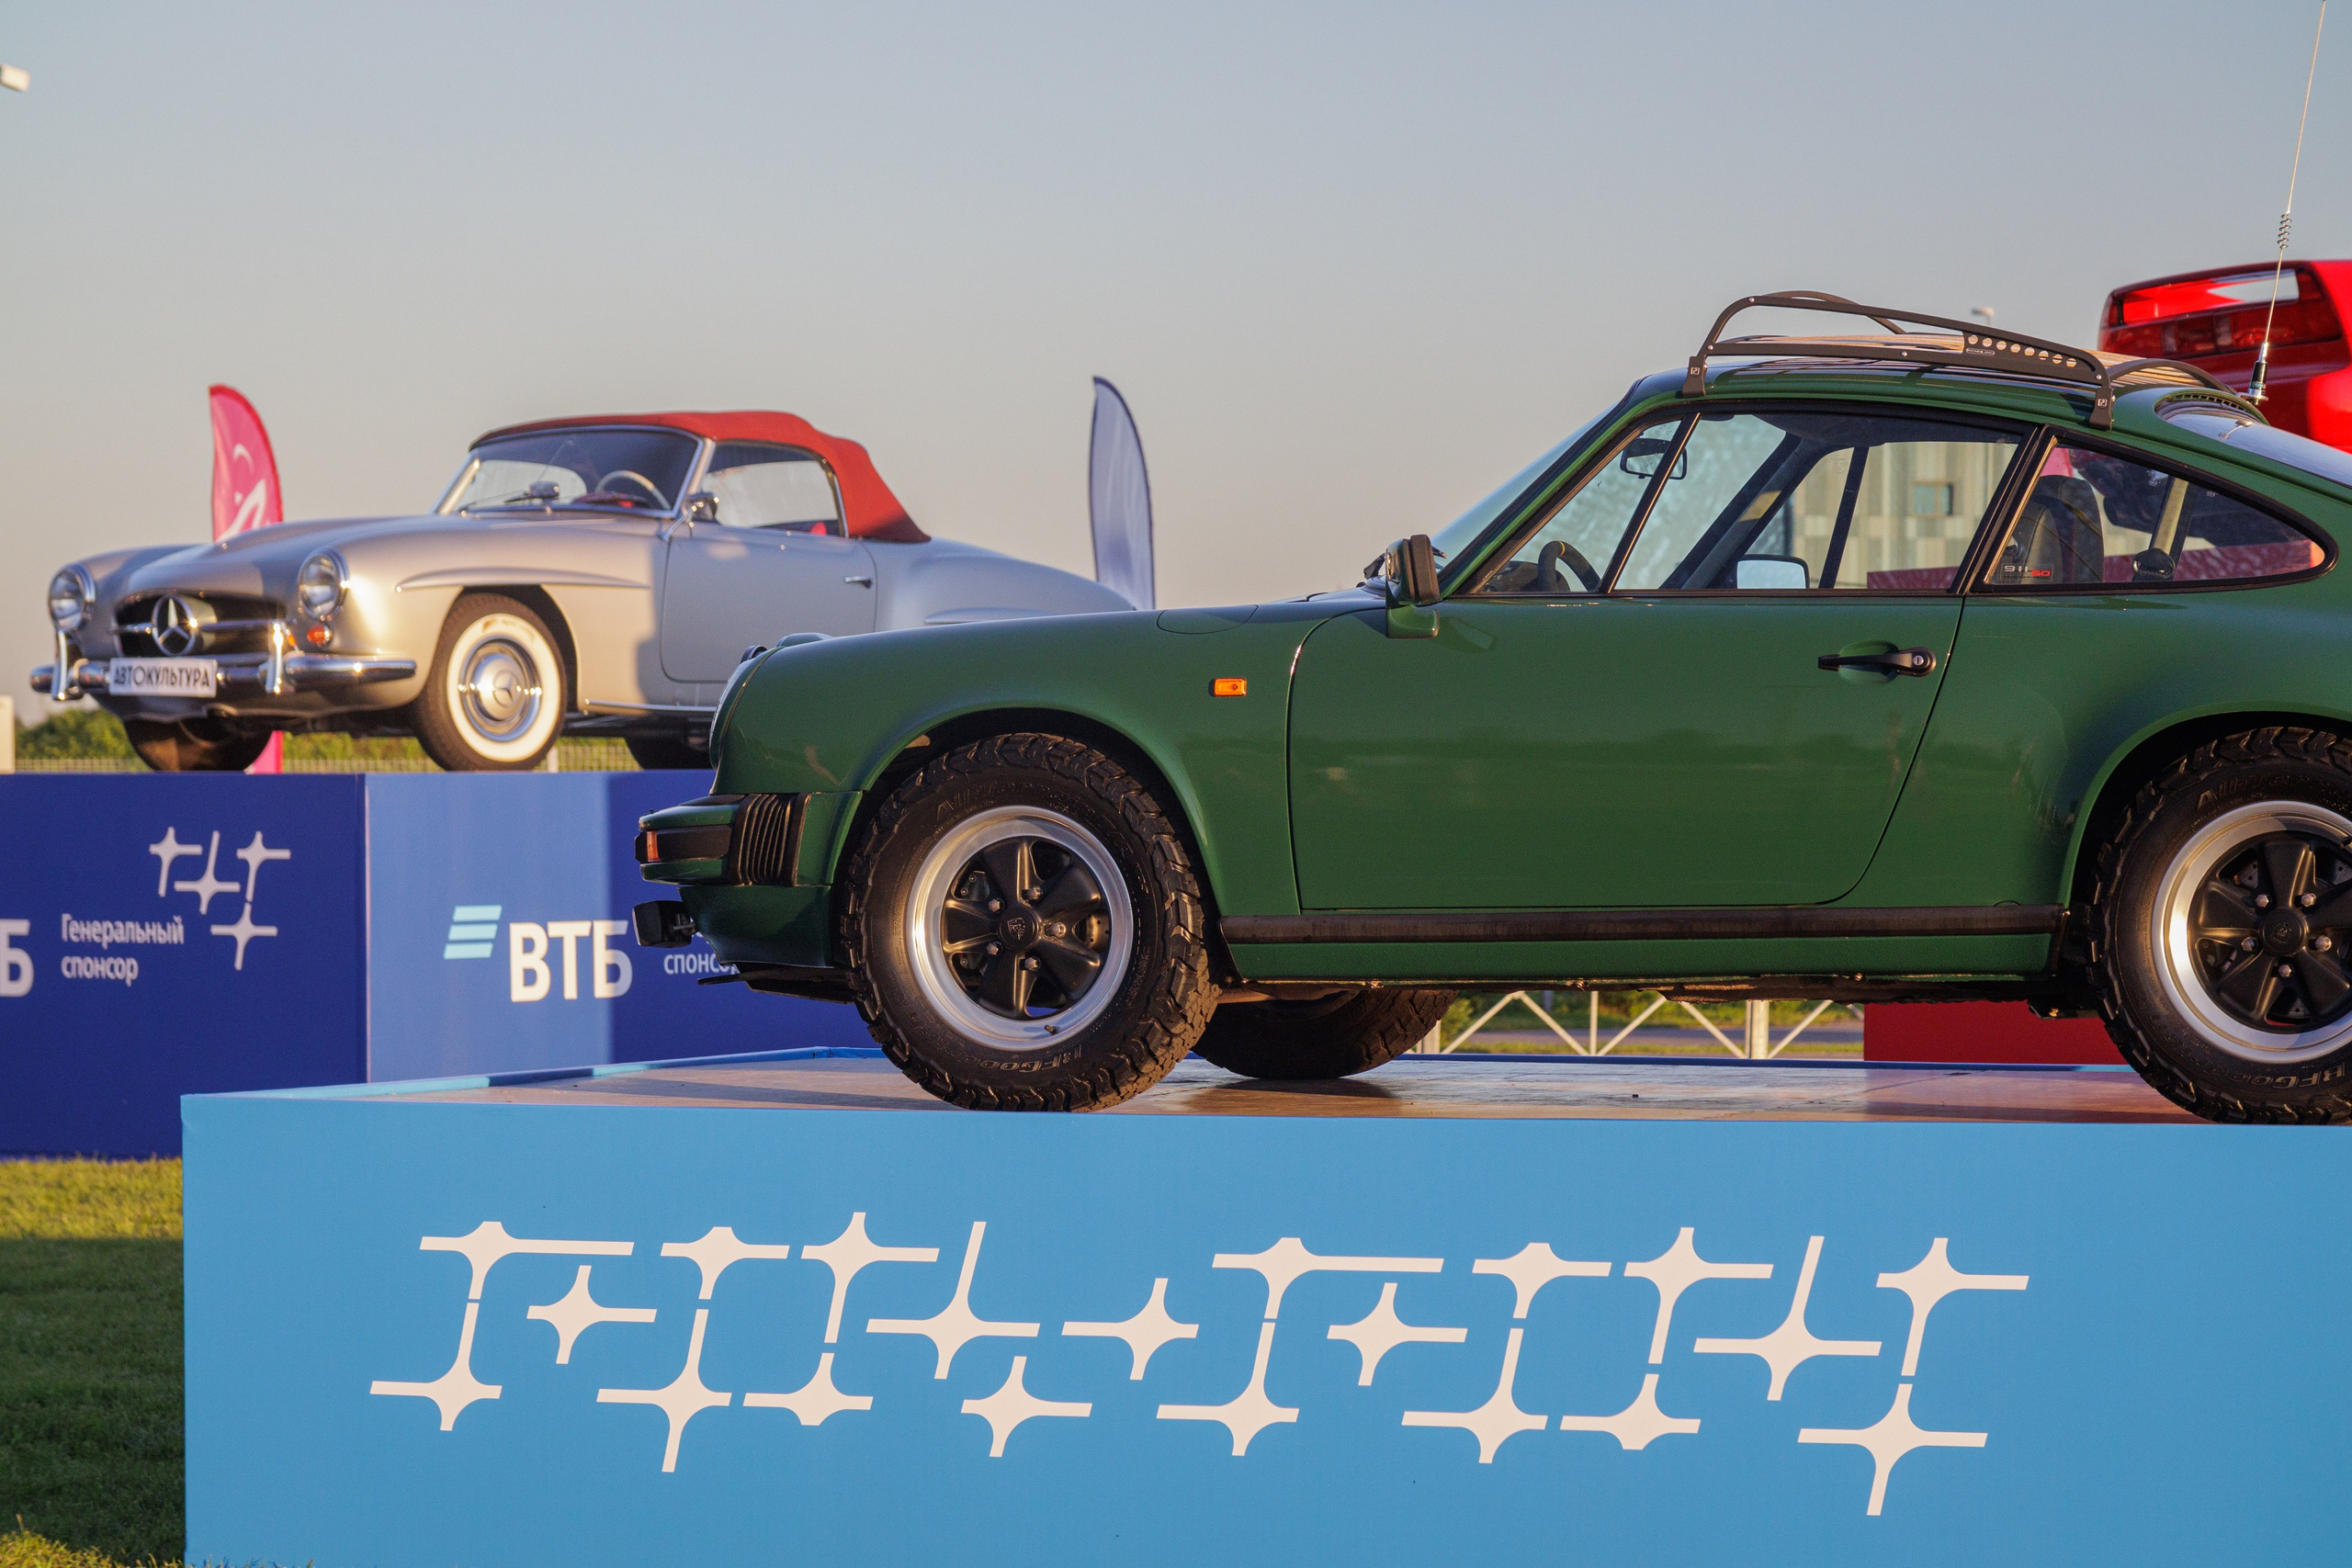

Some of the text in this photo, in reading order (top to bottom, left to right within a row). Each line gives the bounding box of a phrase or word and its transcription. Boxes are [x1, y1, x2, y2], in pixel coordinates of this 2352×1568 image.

[114, 665, 209, 687] АВТОКУЛЬТУРА
[61, 913, 184, 950] Генеральный
[61, 955, 139, 987] спонсор
[509, 919, 633, 1002] ВТБ
[663, 953, 741, 975] спонс
